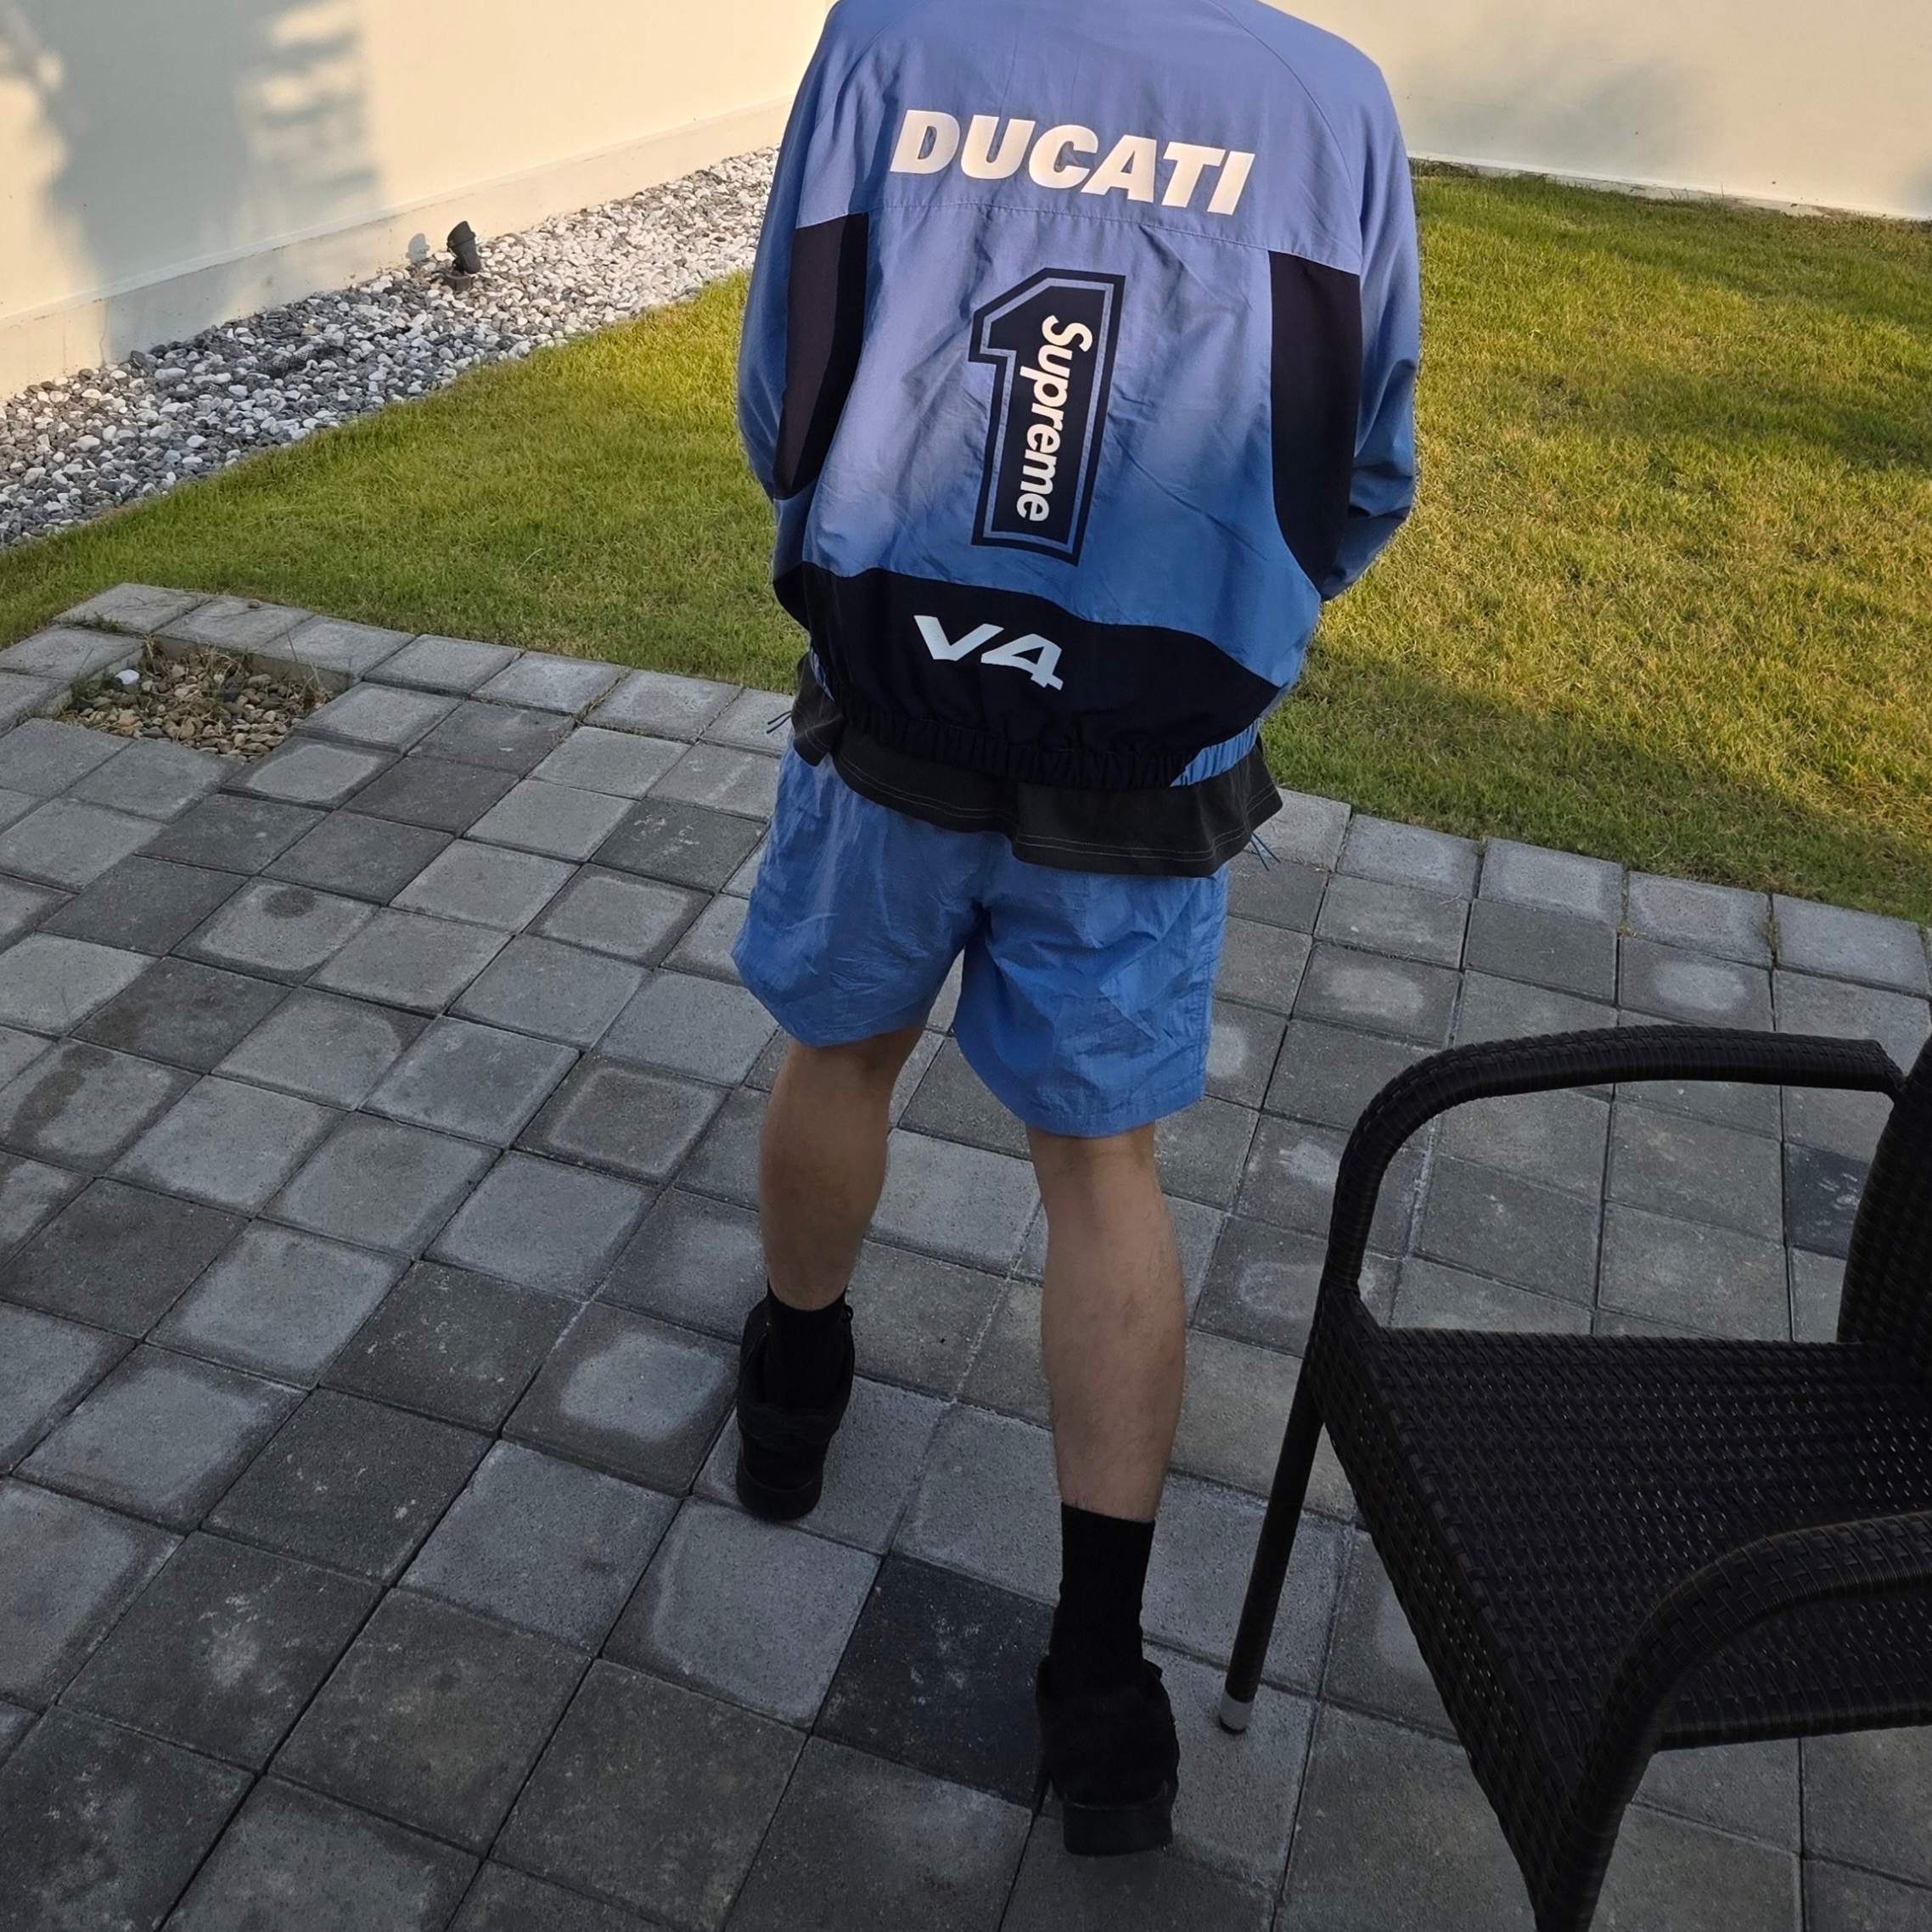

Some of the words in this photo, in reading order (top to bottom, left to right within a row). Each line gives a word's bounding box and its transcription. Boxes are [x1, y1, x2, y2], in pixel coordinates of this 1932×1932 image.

[890, 110, 1255, 216] DUCATI
[968, 267, 1126, 567] 1
[1016, 314, 1093, 522] Supreme
[913, 615, 1064, 691] V4
